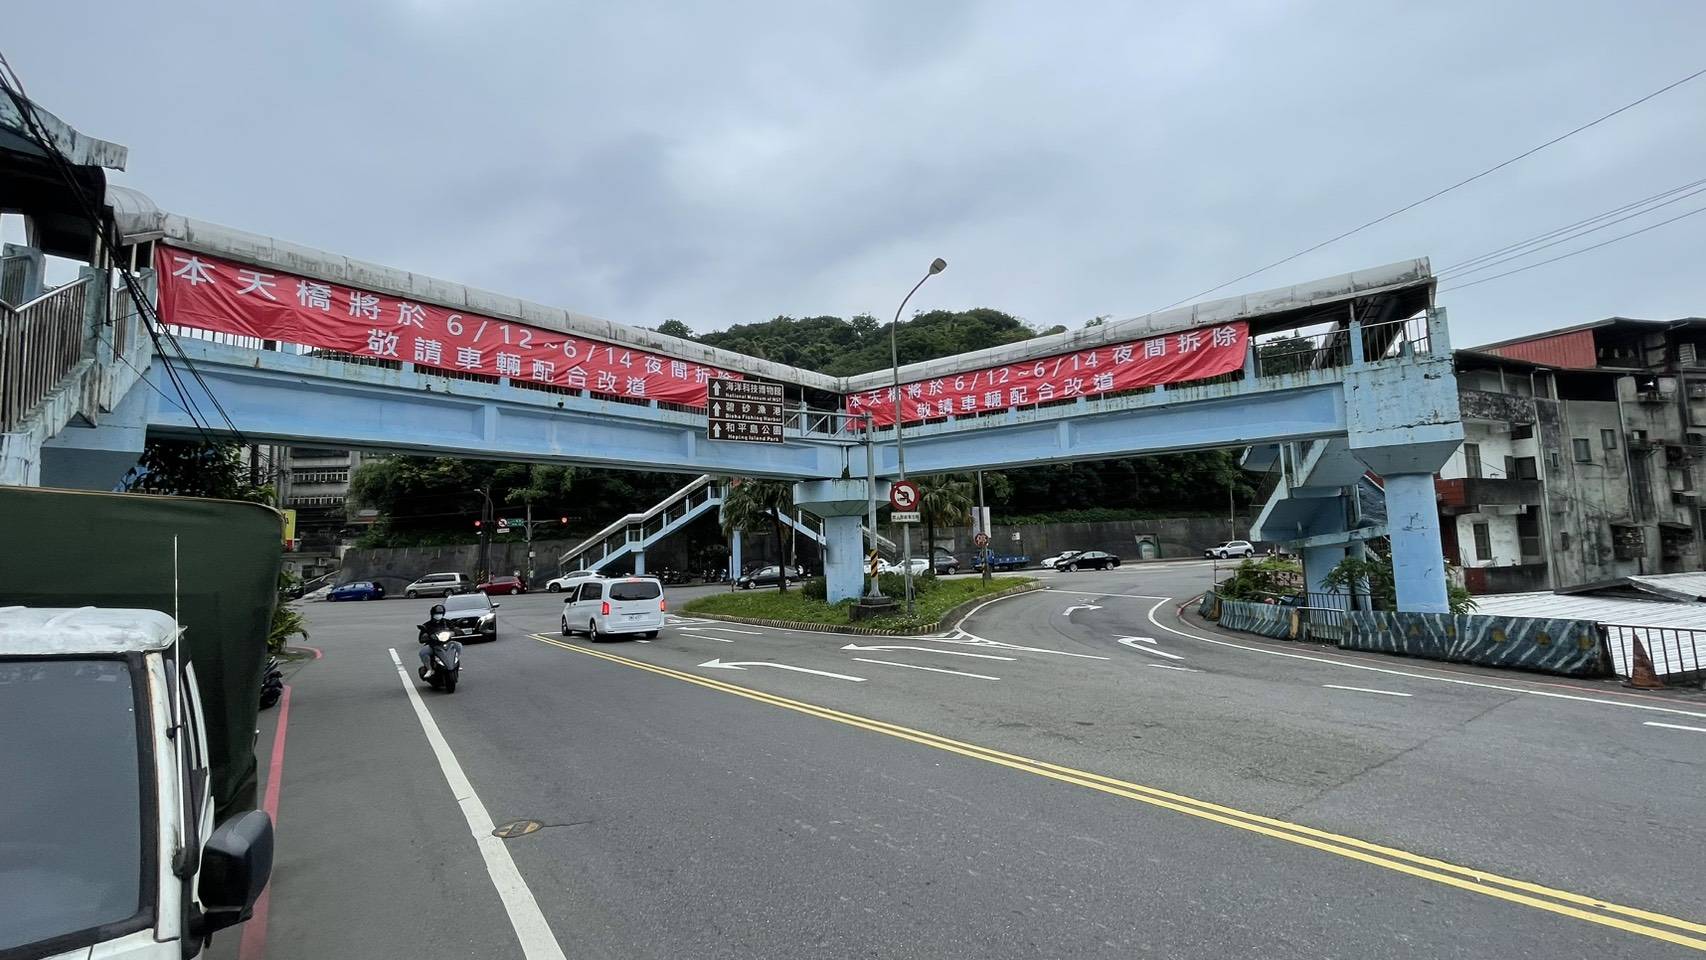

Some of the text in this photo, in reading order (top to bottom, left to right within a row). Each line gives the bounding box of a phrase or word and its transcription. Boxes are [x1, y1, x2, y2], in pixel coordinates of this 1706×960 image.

[367, 328, 646, 397] 敬請車輛配合改道
[726, 382, 781, 396] 海洋科技博物館
[916, 372, 1114, 419] 敬請車輛配合改道
[726, 402, 781, 416] 碧砂漁港
[726, 423, 781, 435] 和平島公園
